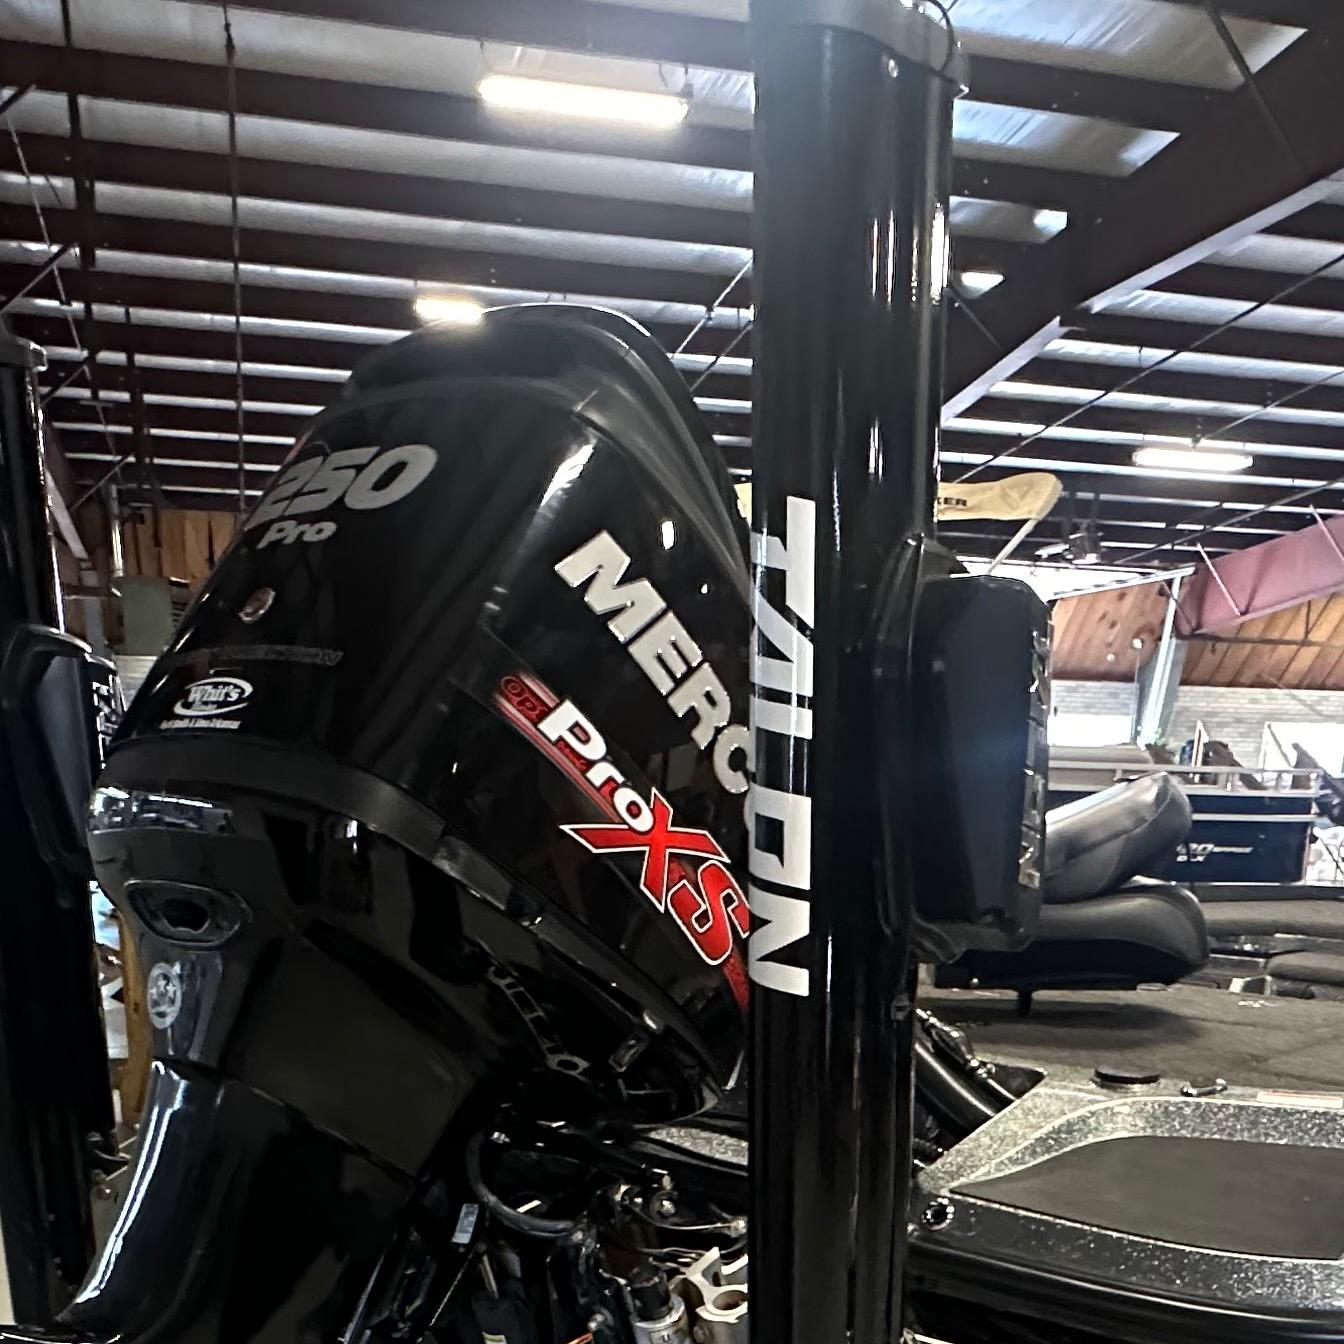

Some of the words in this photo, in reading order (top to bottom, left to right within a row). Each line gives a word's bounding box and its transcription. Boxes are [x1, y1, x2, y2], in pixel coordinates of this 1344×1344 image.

[244, 444, 438, 532] 250
[256, 520, 338, 549] Pro
[750, 496, 817, 996] TALON
